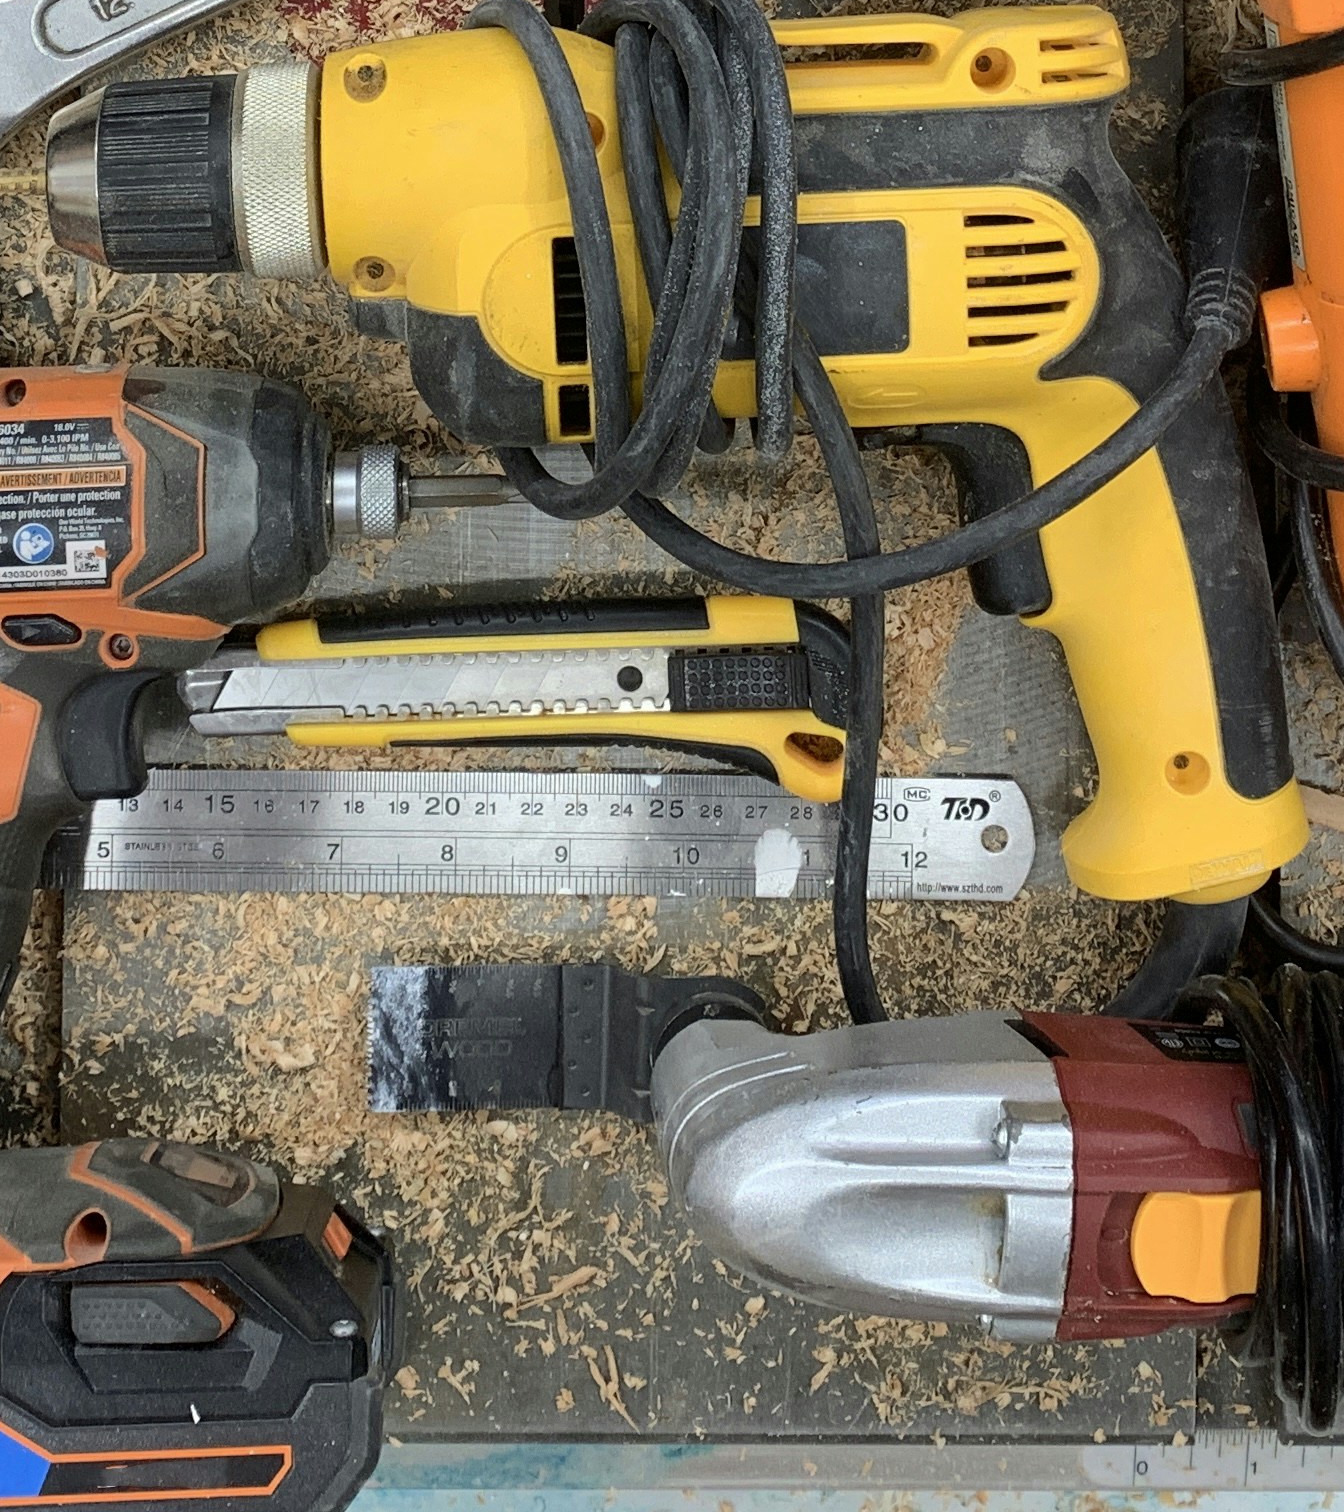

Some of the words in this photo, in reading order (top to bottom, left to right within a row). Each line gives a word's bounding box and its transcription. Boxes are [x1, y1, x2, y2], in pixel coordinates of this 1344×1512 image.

[54, 422, 76, 432] 18.0V
[0, 472, 63, 487] AVERTISSEMENT
[69, 470, 122, 485] ADVERTENCIA
[33, 491, 59, 504] Porter
[60, 493, 76, 503] une
[77, 490, 122, 504] protection
[18, 506, 66, 522] protección
[67, 504, 98, 517] ocular.
[117, 799, 139, 812] 13
[162, 799, 184, 813] 14
[204, 794, 235, 814] 15
[253, 800, 275, 813] 16
[298, 800, 320, 813] 17
[343, 801, 365, 814] 18
[388, 801, 410, 815] 19
[424, 797, 461, 816] 20
[474, 802, 497, 815] 21
[520, 803, 544, 816] 22
[564, 803, 589, 817] 23
[609, 803, 634, 817] 24
[649, 799, 684, 818] 25
[699, 804, 723, 818] 26
[744, 805, 768, 819] 27
[790, 806, 813, 820] 28
[872, 803, 909, 821] 30
[97, 841, 110, 859] 5
[212, 843, 225, 860] 6
[326, 843, 340, 860] 7
[440, 844, 454, 862] 8
[555, 845, 568, 863] 9
[673, 847, 700, 864] 10
[901, 851, 929, 868] 12
[916, 881, 1004, 895] http://www.szthd.com
[1136, 1461, 1149, 1476] 0
